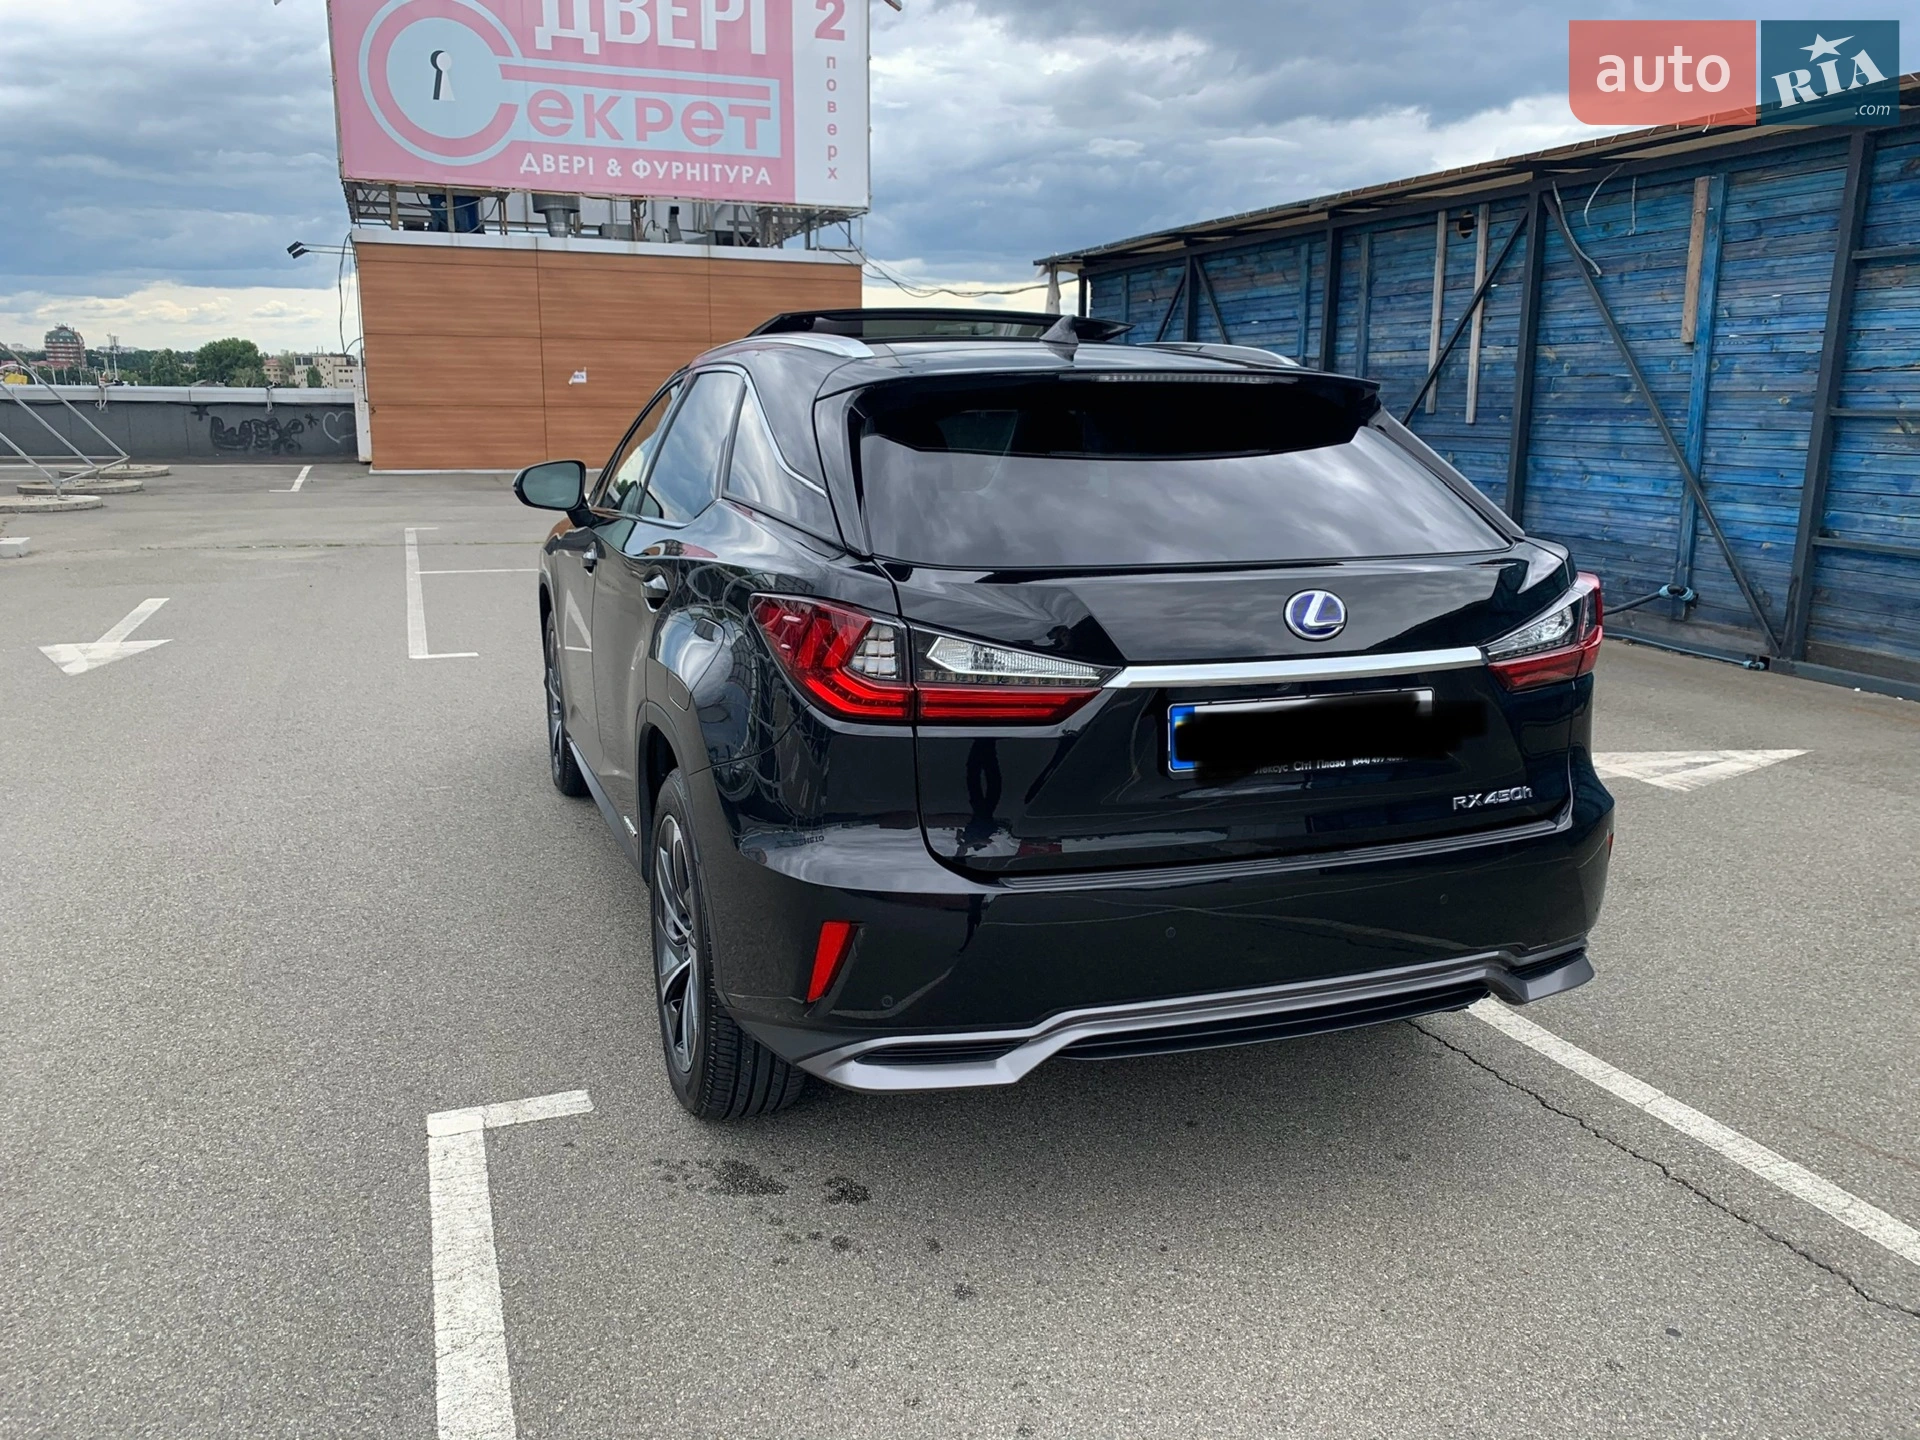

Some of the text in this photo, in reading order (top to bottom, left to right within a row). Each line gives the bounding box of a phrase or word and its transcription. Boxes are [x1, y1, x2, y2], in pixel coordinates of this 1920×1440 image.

[815, 0, 845, 41] 2
[826, 56, 838, 180] поверх
[519, 152, 772, 186] ДВЕРІ & ФУРНІТУРА
